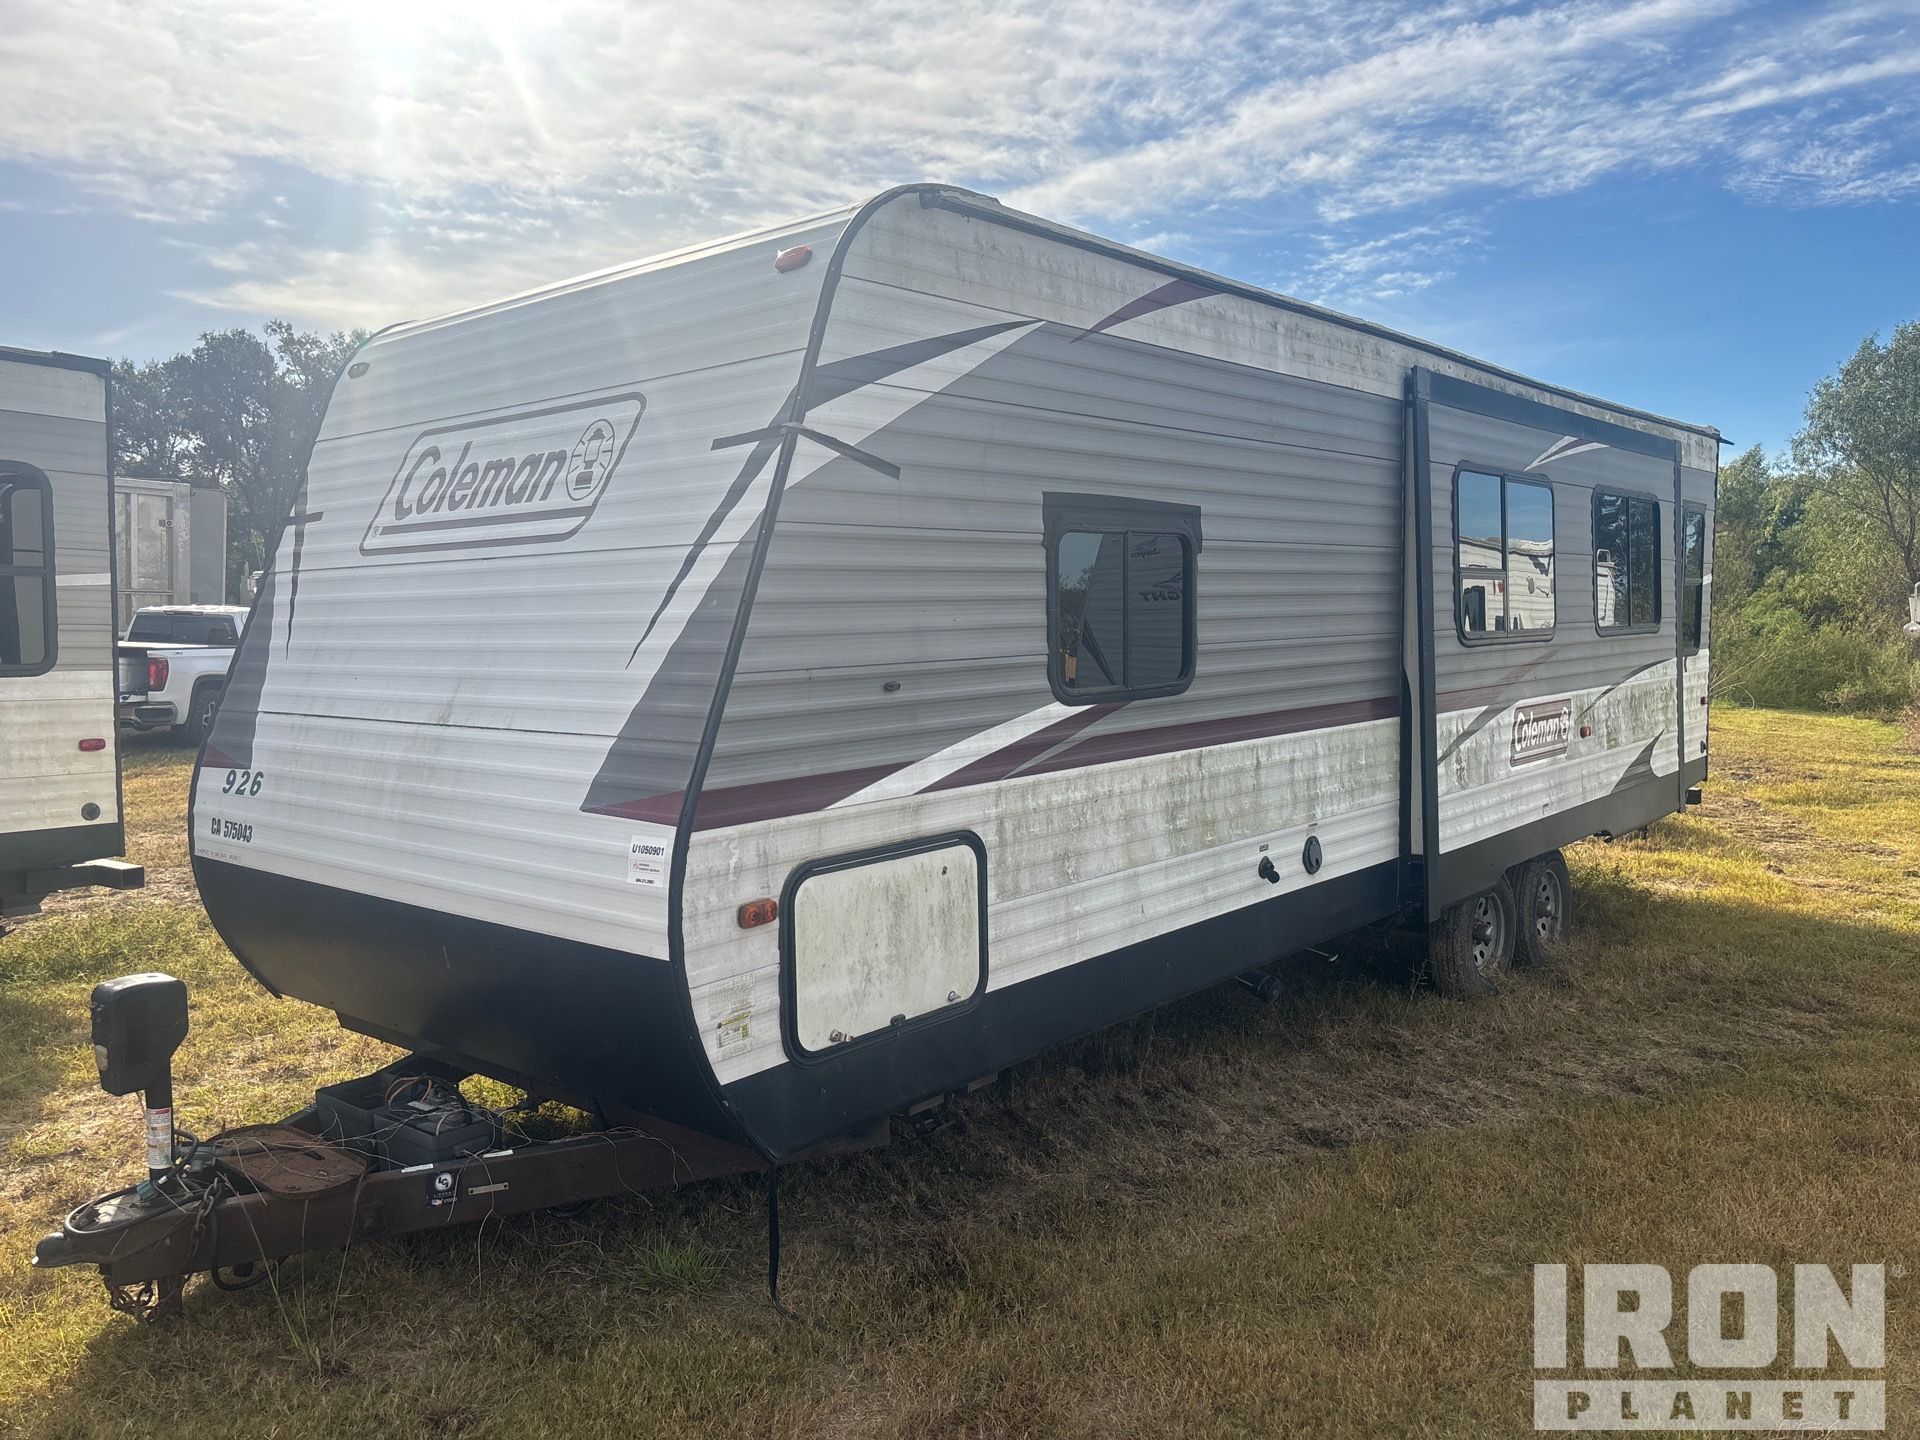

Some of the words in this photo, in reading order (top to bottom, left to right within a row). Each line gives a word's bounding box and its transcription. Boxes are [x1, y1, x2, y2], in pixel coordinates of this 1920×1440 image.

[394, 440, 568, 521] Coleman
[1514, 711, 1560, 752] Coleman
[222, 769, 265, 797] 926
[211, 817, 221, 836] CA
[223, 820, 253, 843] 575043
[631, 843, 665, 857] U1050901
